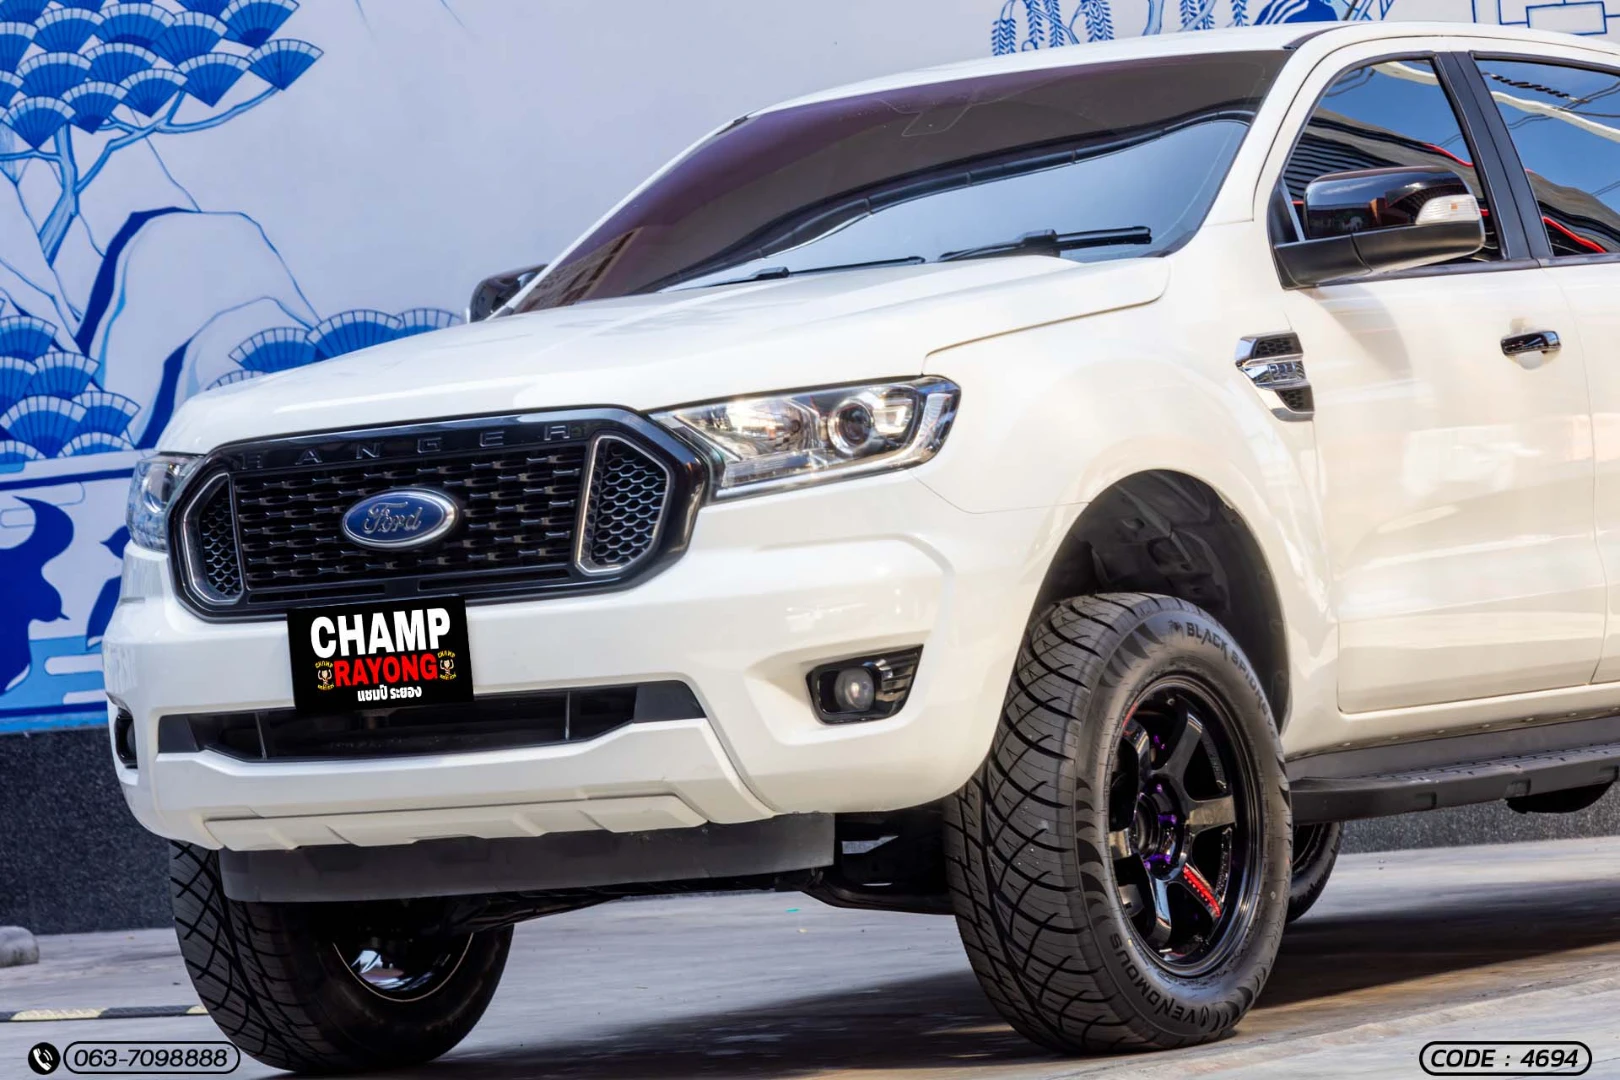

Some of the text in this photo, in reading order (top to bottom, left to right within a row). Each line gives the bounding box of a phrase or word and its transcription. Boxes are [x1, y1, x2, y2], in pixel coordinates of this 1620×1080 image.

[237, 424, 570, 470] RANGER
[363, 501, 423, 535] Ford
[1186, 621, 1228, 661] BLACK
[1109, 932, 1195, 1024] VENOMOUS
